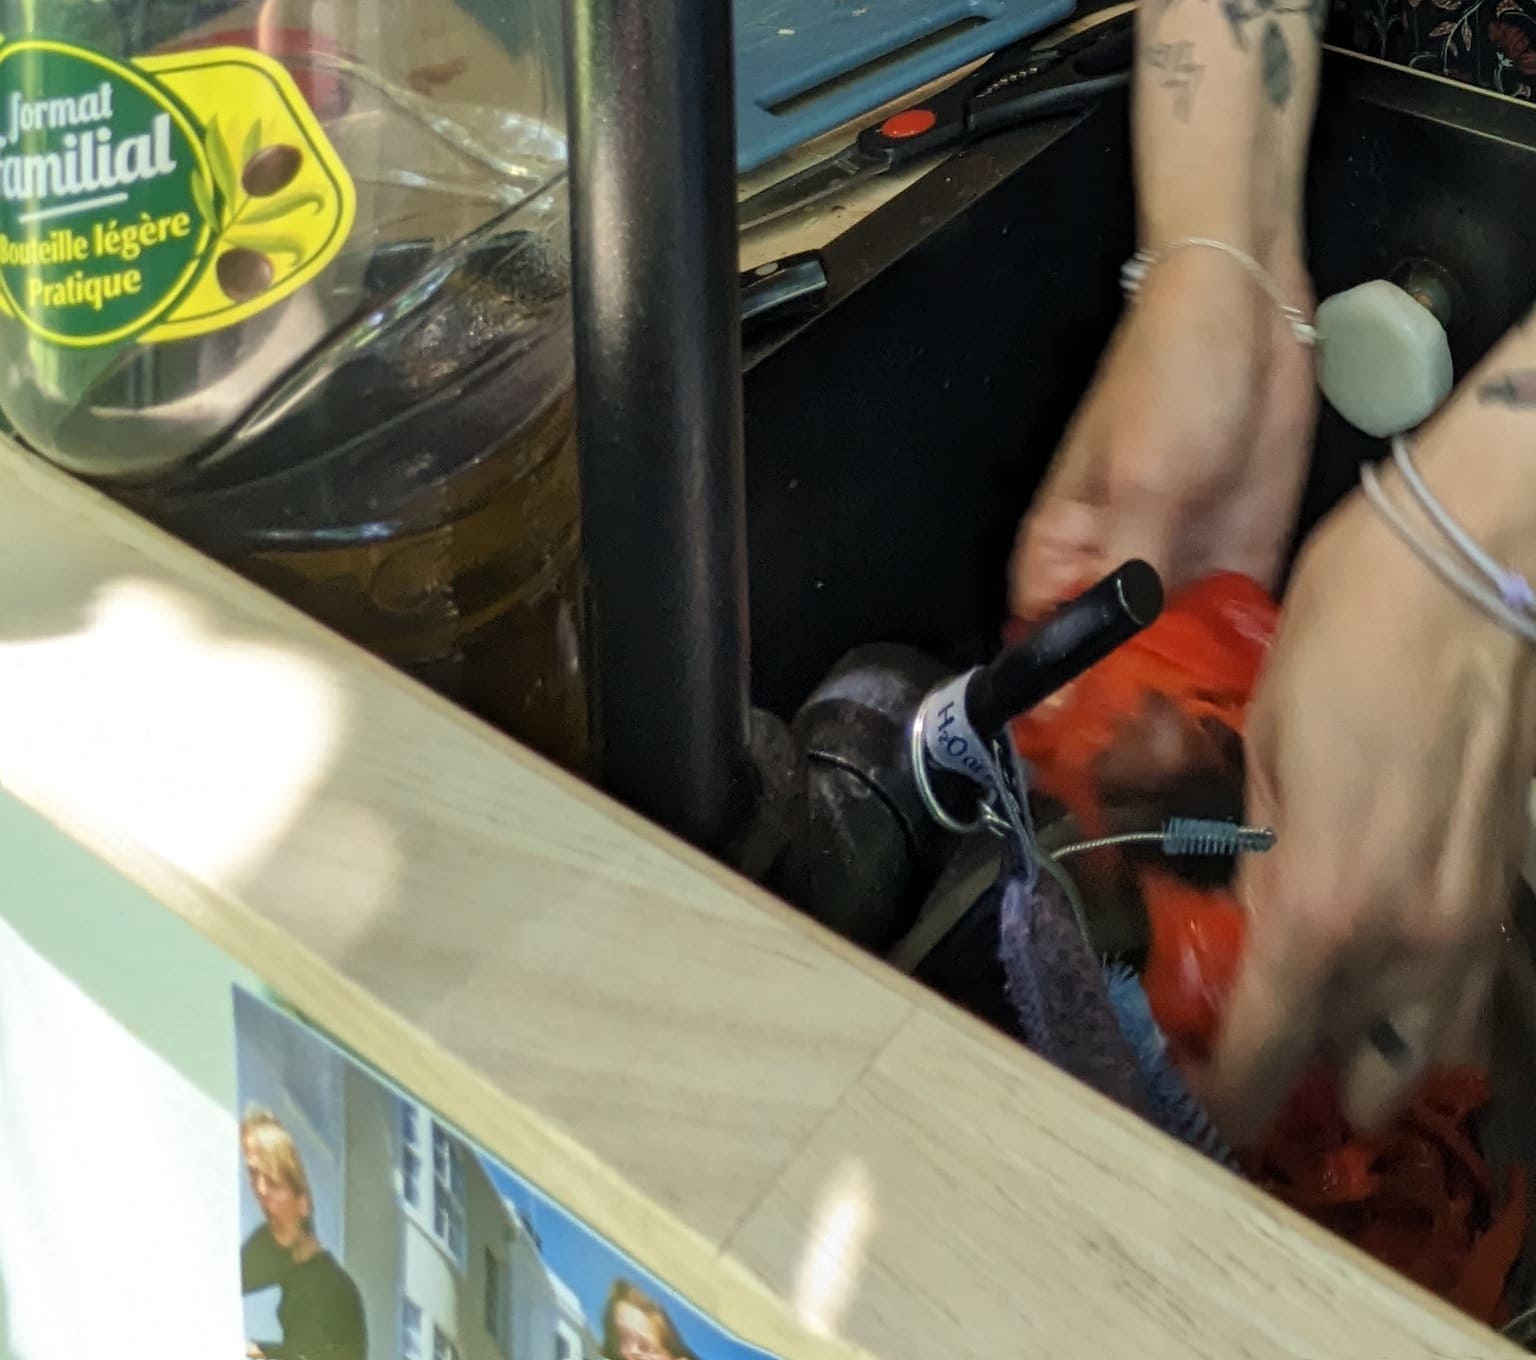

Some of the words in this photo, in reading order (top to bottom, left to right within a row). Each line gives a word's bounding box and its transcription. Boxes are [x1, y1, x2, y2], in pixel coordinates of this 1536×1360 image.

[9, 82, 113, 144] format
[0, 113, 176, 202] amilial
[94, 211, 191, 260] légère
[29, 271, 142, 311] Pratique
